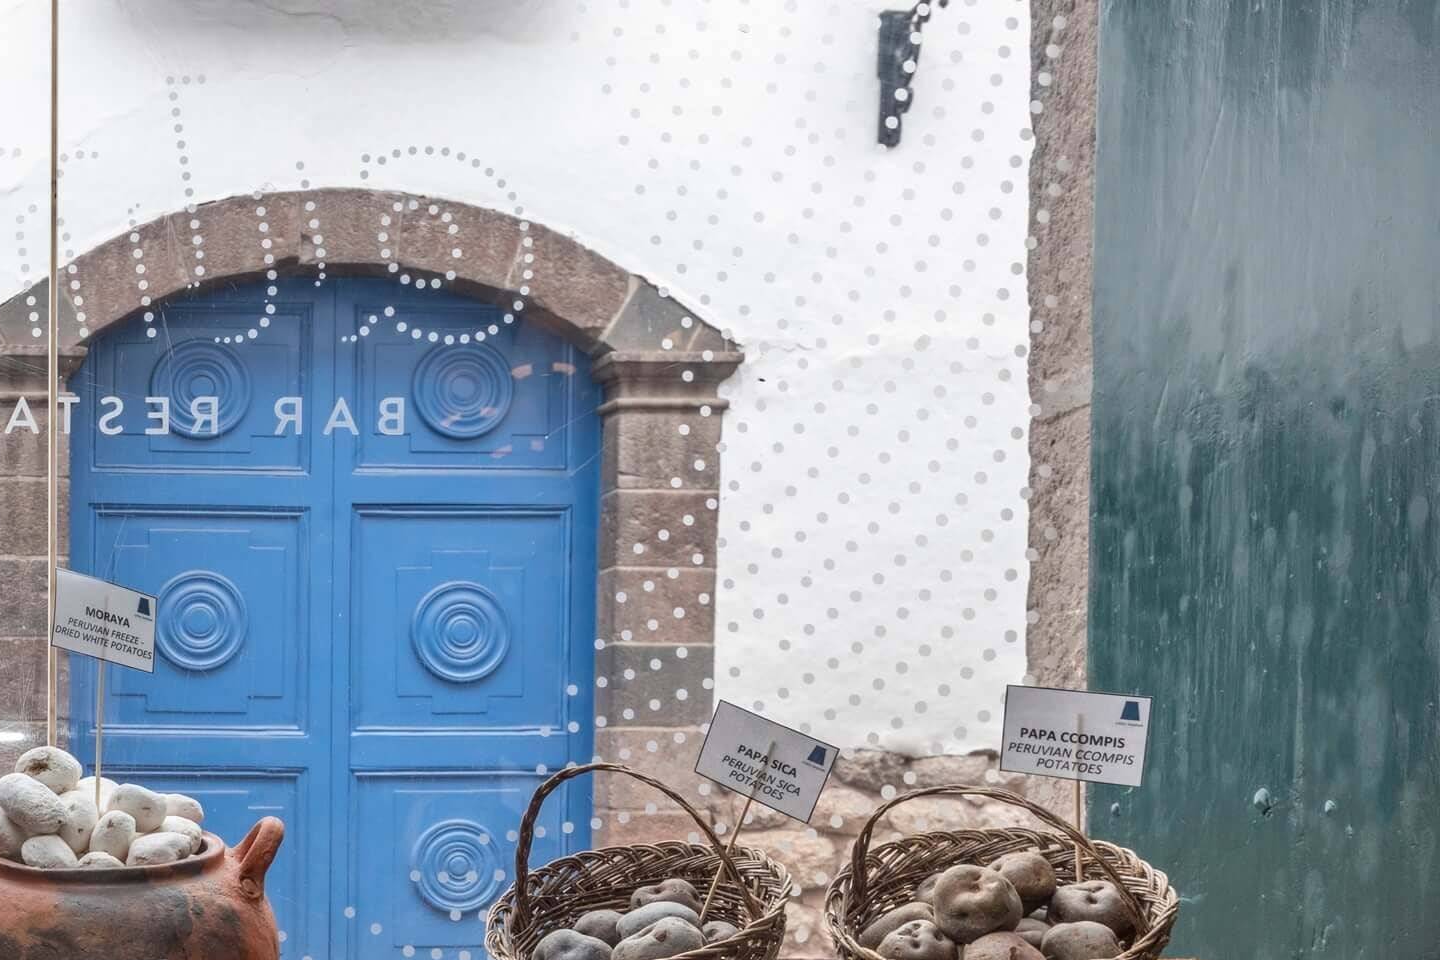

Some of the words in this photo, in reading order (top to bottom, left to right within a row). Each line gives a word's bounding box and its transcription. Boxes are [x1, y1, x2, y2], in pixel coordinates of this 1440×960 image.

[68, 617, 109, 636] PERUVIAN
[86, 606, 130, 628] MORAYA
[55, 625, 80, 638] DRIED
[83, 633, 109, 647] WHITE
[111, 641, 152, 659] POTATOES
[1020, 728, 1056, 741] PAPA
[1060, 732, 1125, 748] CCOMPIS
[738, 745, 768, 764] PAPA
[771, 759, 797, 778] SICA
[1008, 742, 1072, 758] PERUVIAN
[1075, 749, 1134, 765] CCOMPIS
[722, 755, 776, 784] PERUVIAN
[778, 779, 800, 796] SICA
[1036, 758, 1103, 774] POTATOES
[729, 770, 784, 800] POTATOES
